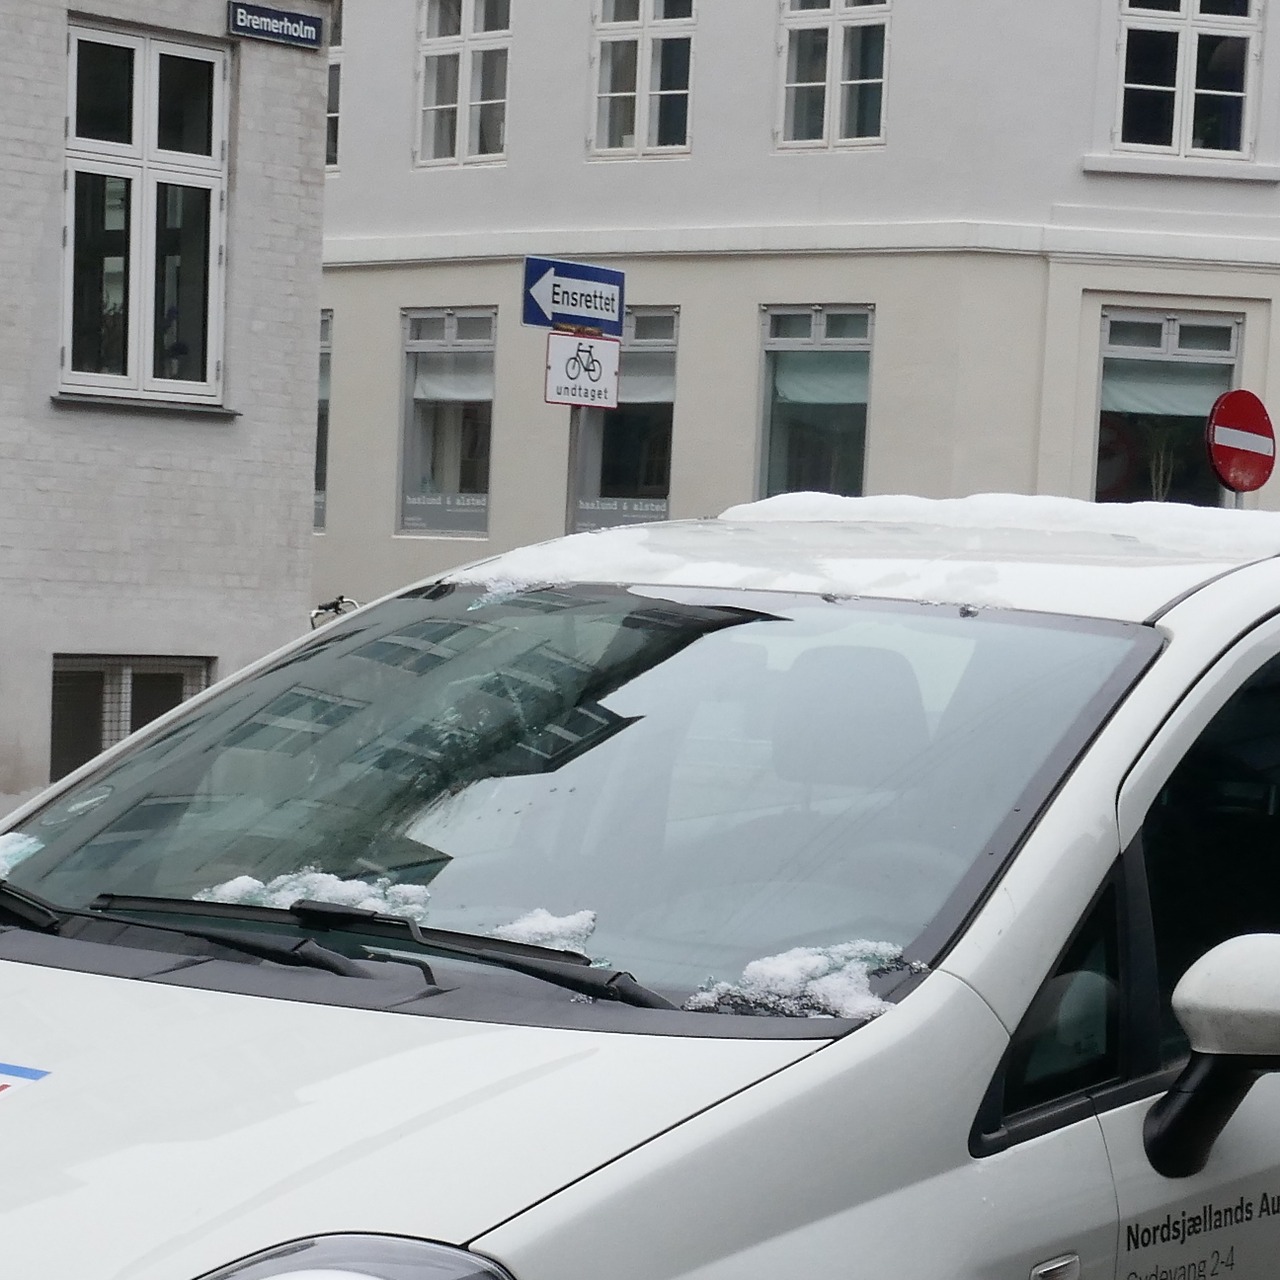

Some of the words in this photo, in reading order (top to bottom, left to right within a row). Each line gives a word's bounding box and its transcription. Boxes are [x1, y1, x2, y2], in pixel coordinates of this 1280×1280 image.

[236, 8, 316, 40] Bremerholm
[551, 283, 616, 313] Ensrettet
[556, 384, 609, 401] undtaget
[1126, 1196, 1253, 1251] Nordsjællands
[1210, 1246, 1235, 1276] 2-4
